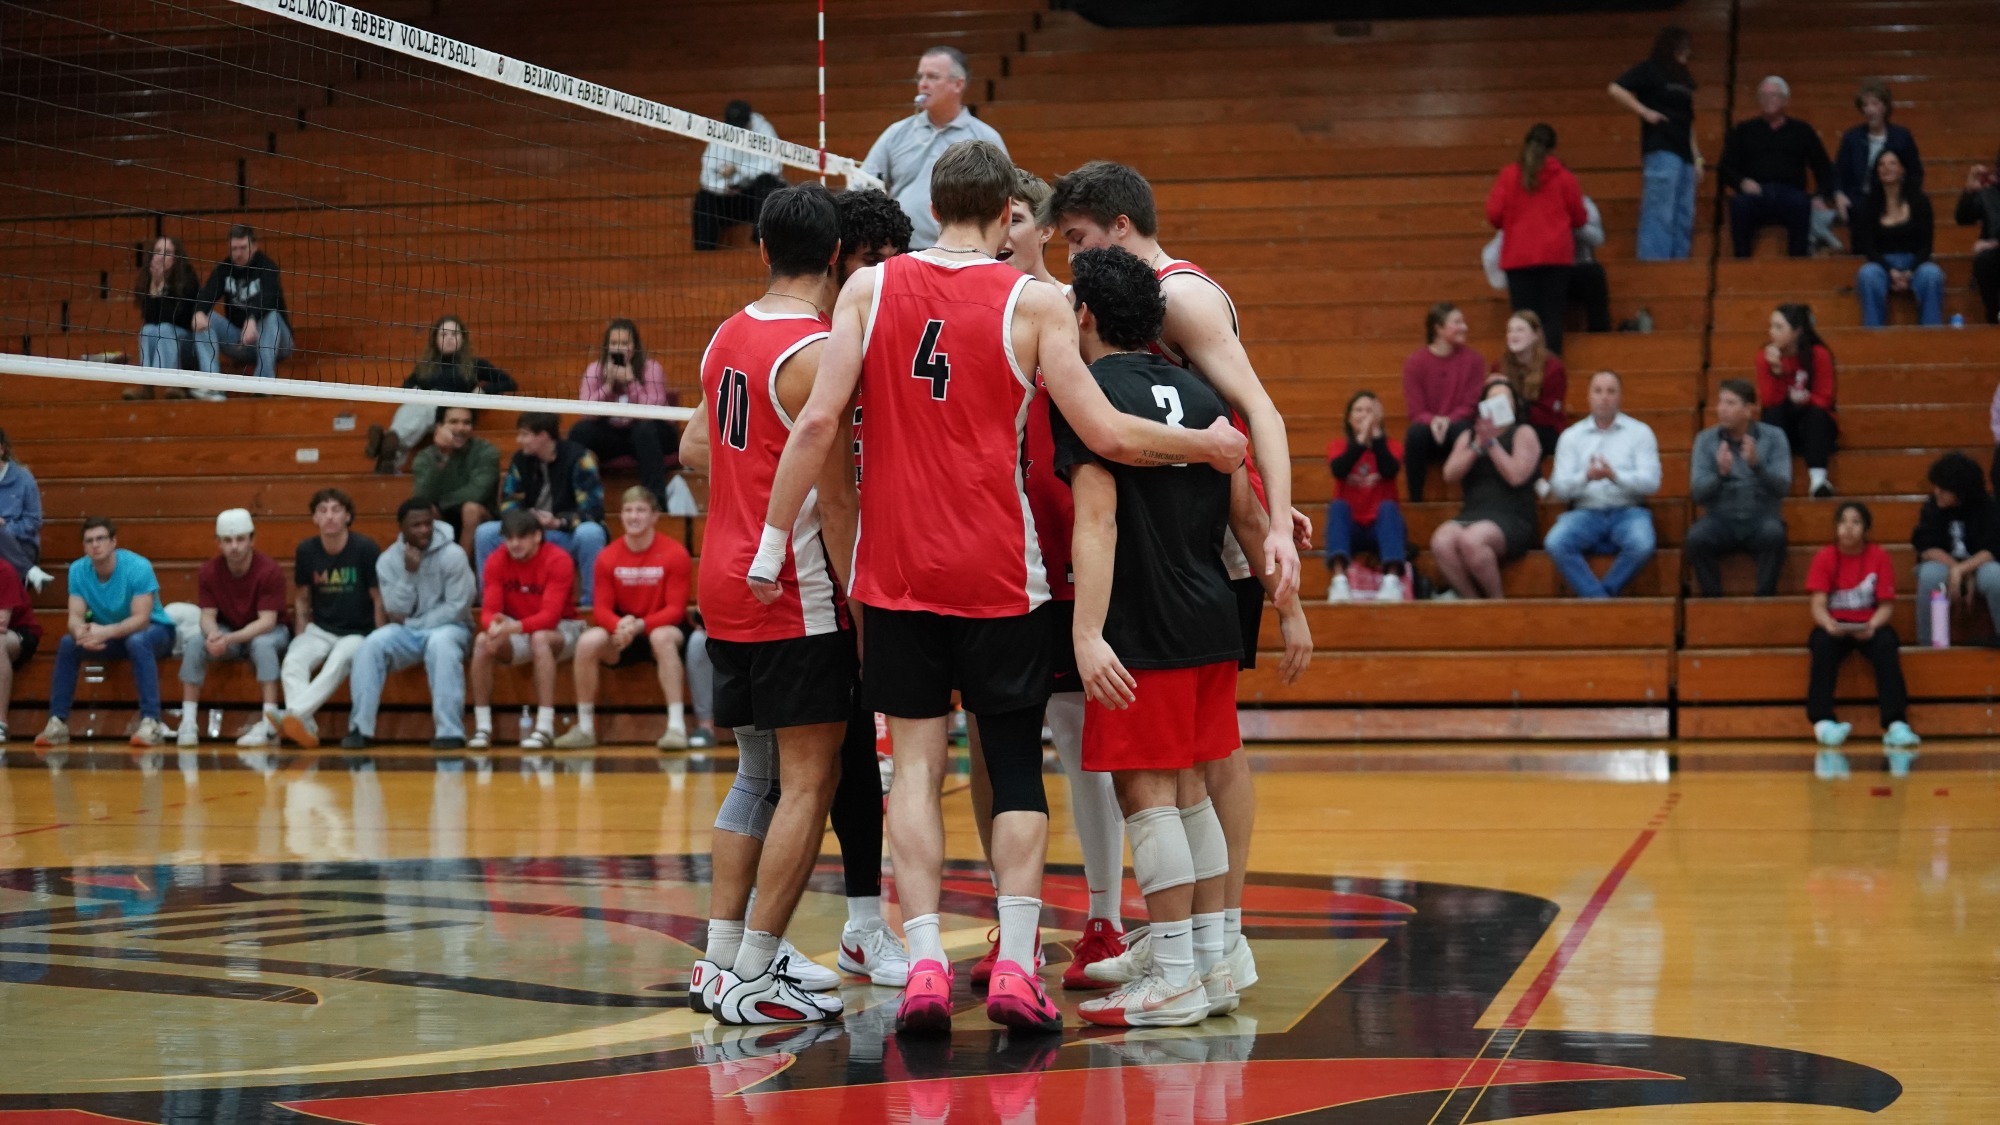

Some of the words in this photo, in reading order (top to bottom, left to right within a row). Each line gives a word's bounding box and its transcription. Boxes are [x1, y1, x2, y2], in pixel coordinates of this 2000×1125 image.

[352, 11, 394, 41] ABBEY
[401, 25, 476, 67] VOLLEYBALL
[523, 65, 574, 95] BELMONT
[577, 82, 610, 107] ABBEY
[614, 92, 672, 125] VOLLEYBALL
[911, 319, 951, 401] 4
[717, 366, 750, 451] 10
[313, 567, 357, 585] MAUI
